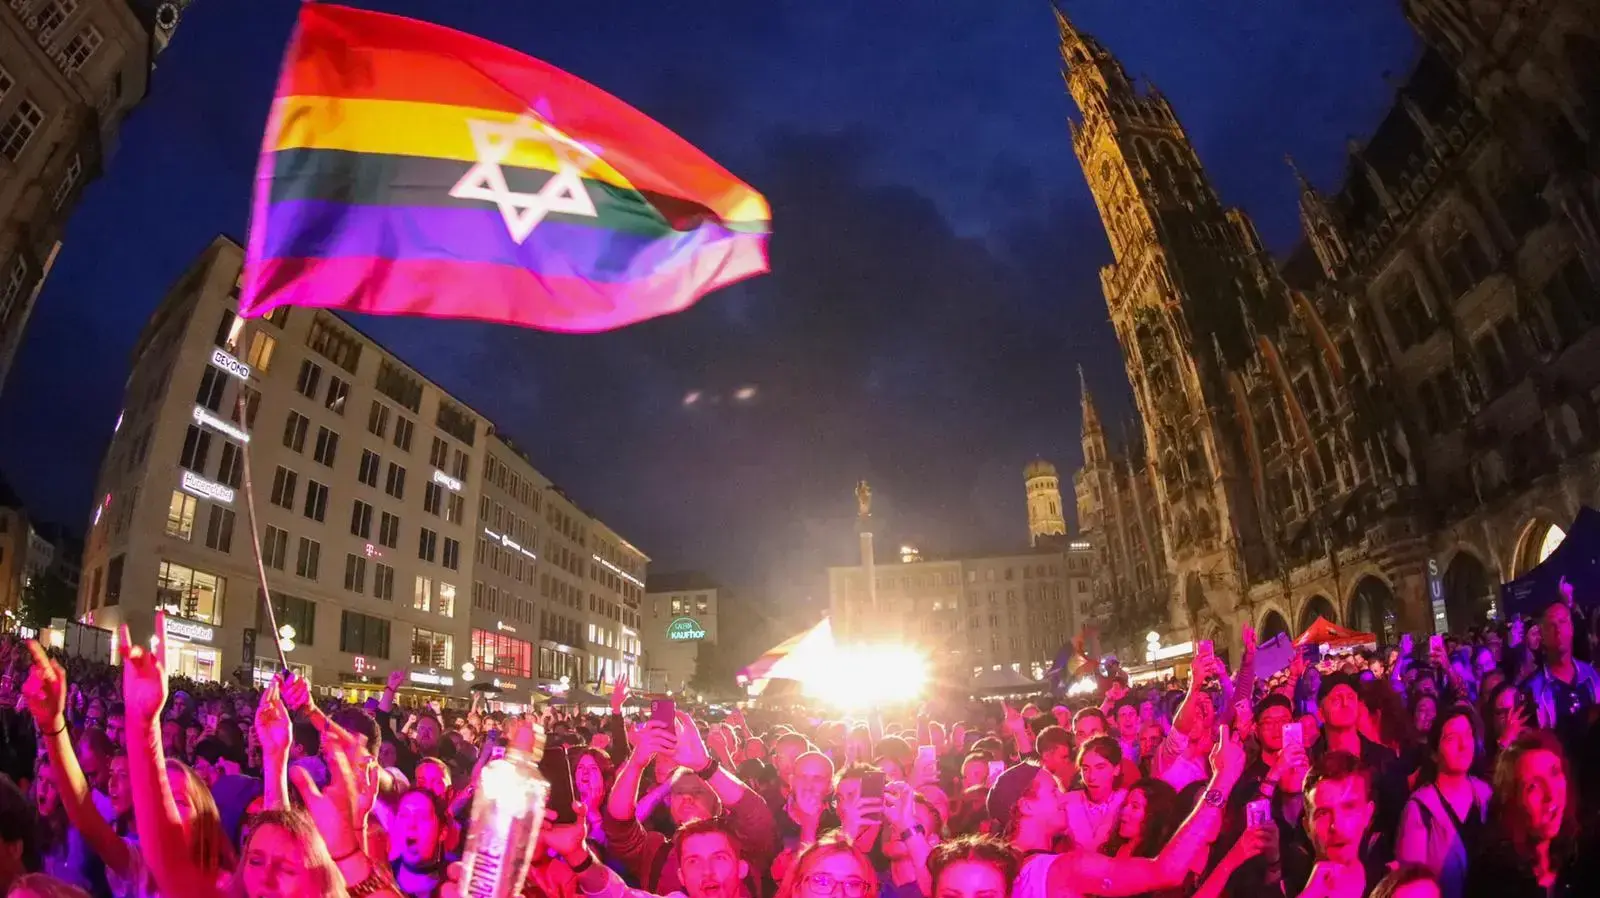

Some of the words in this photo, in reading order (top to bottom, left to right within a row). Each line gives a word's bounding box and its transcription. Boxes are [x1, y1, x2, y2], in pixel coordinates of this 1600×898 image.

[214, 351, 250, 377] BEYOND
[1428, 559, 1438, 576] S
[1431, 580, 1441, 597] U
